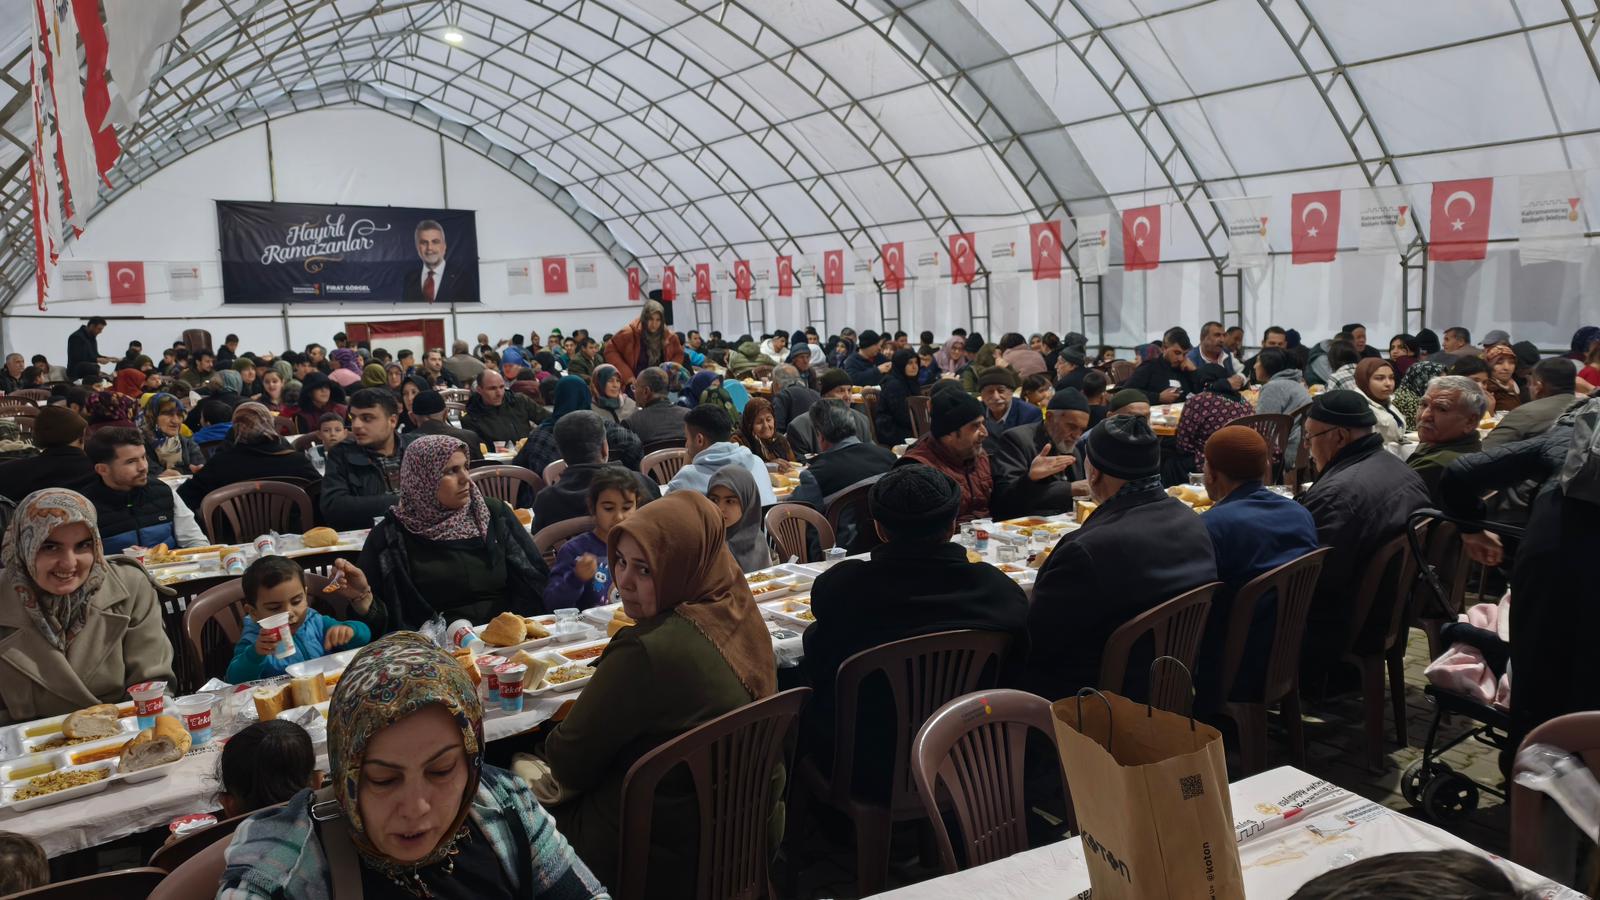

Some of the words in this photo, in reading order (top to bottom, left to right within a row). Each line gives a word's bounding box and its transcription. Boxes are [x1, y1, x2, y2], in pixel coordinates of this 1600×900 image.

[261, 218, 391, 265] Ramazanlar
[286, 213, 346, 246] Hayırlı
[1202, 841, 1215, 881] @koton
